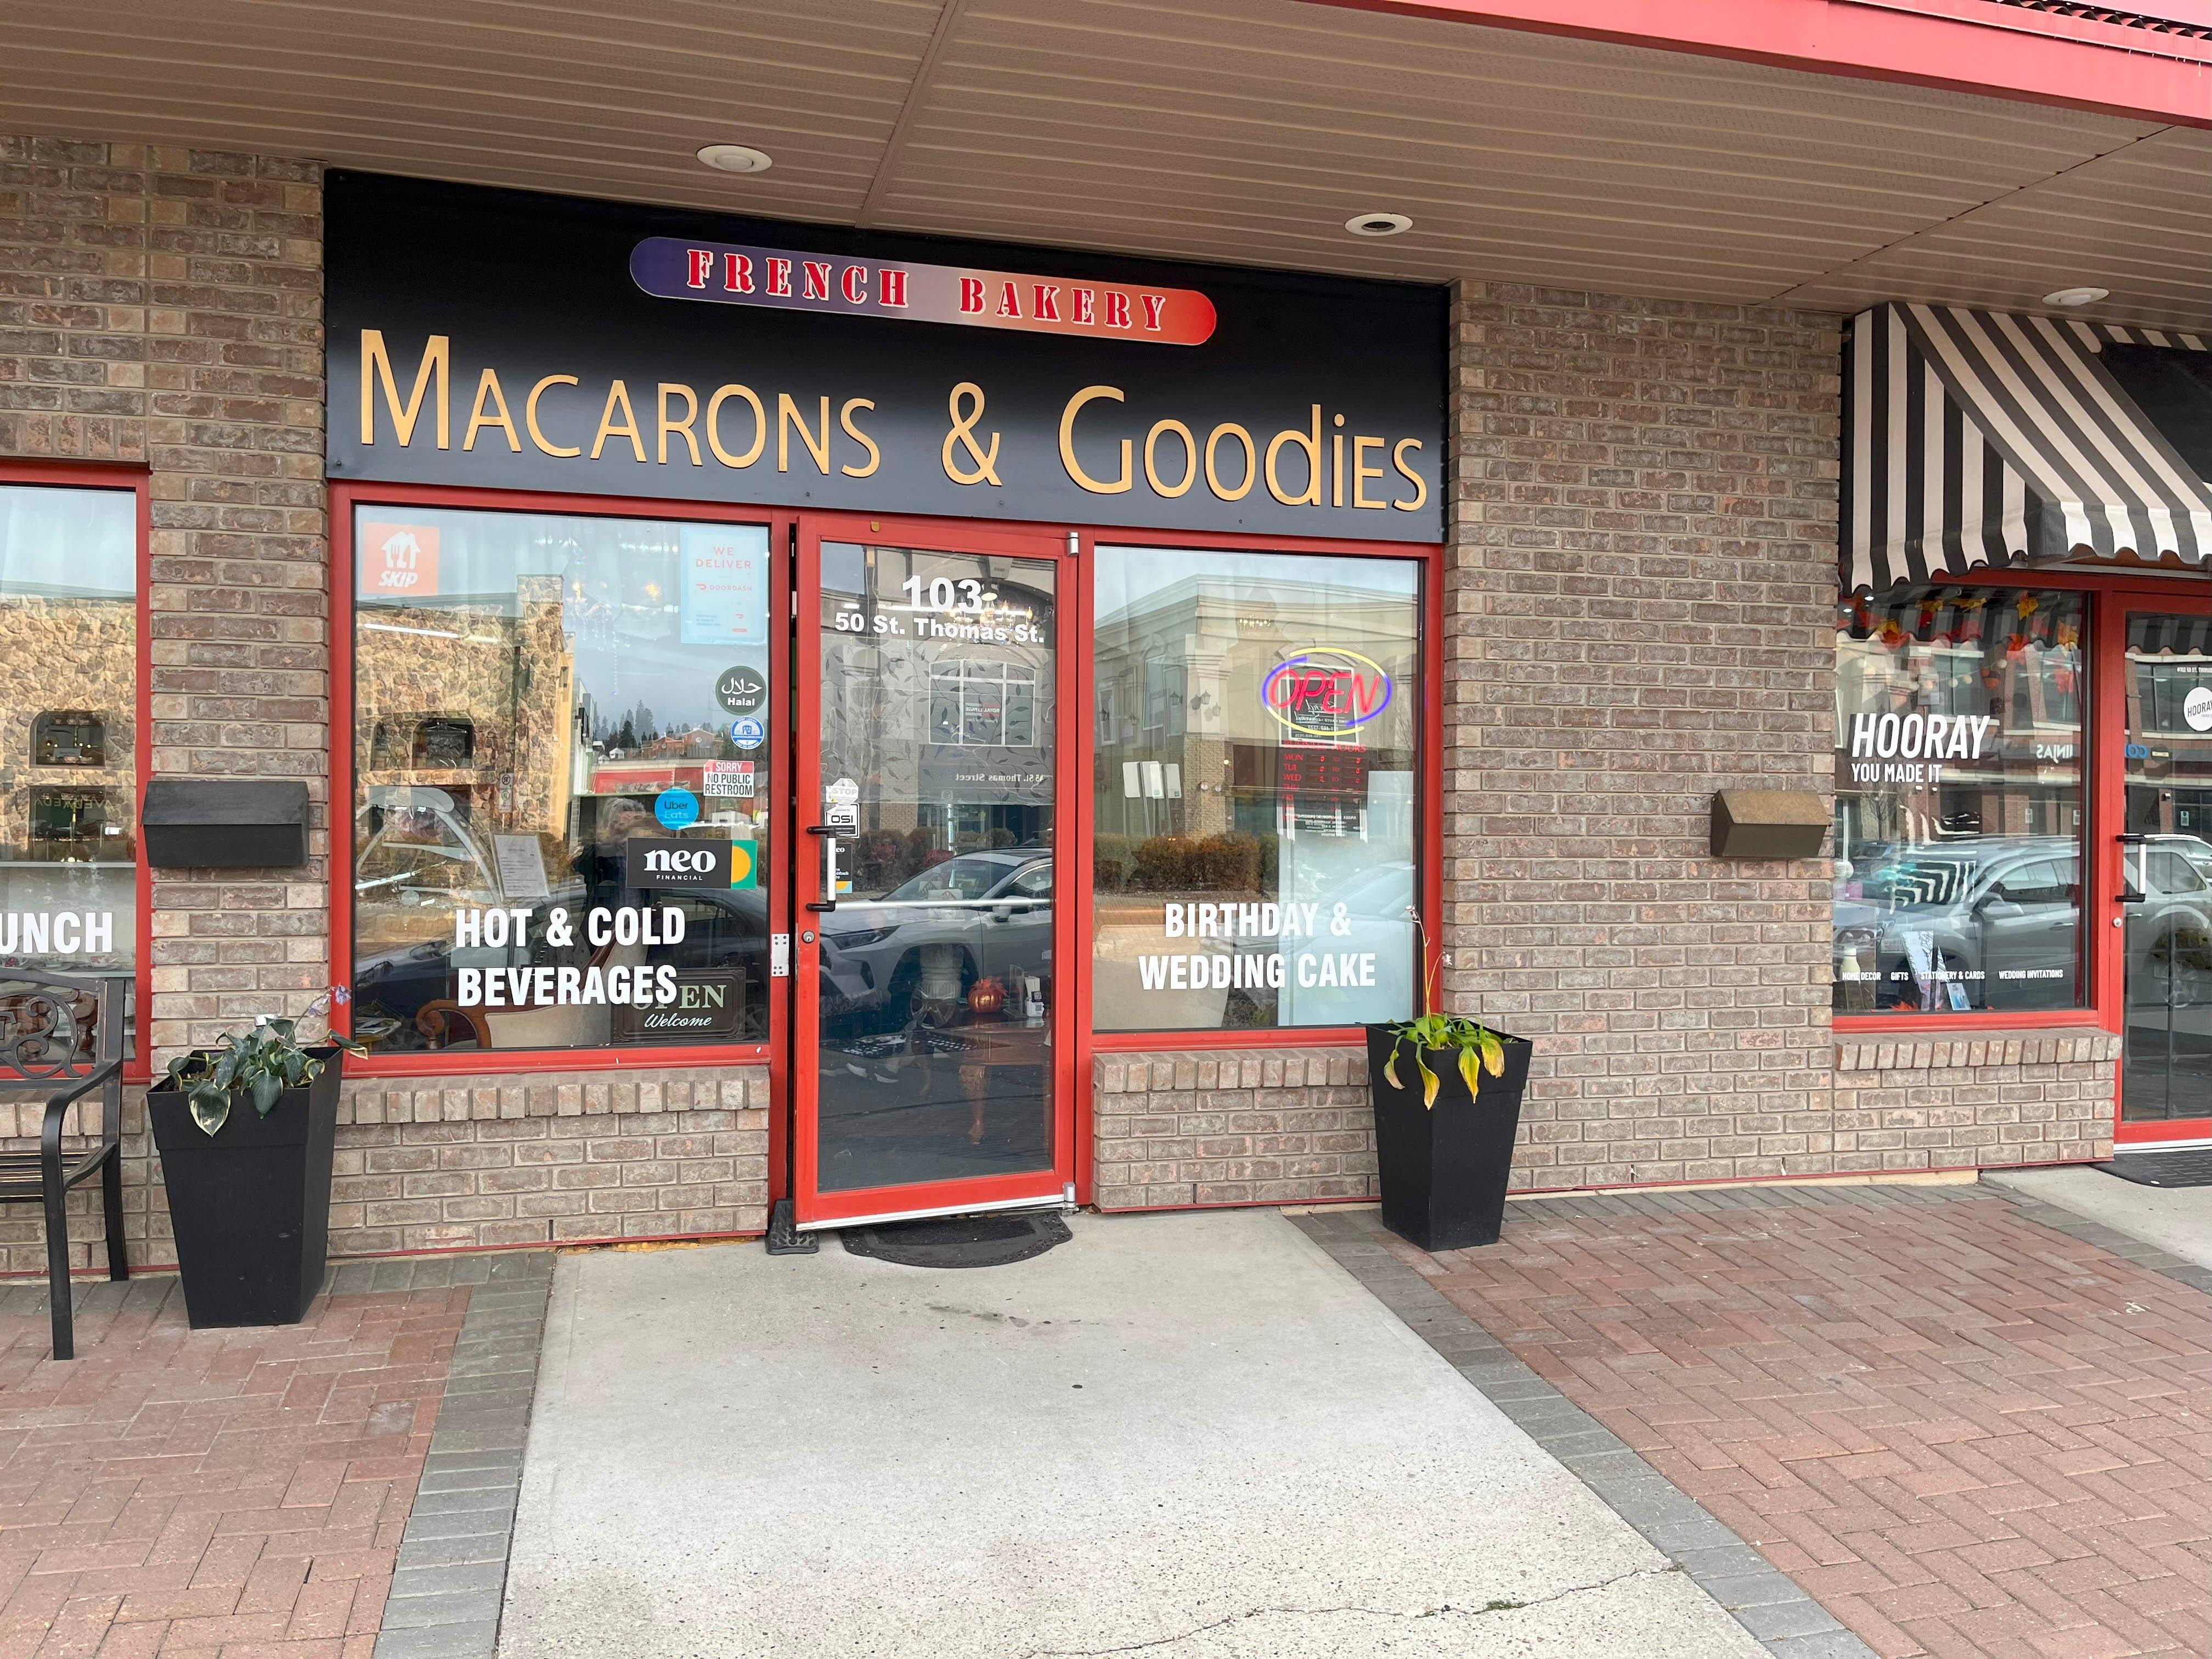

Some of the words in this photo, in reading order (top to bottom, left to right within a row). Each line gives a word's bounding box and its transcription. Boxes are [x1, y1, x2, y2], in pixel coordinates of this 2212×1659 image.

[686, 249, 909, 308] FRENCH
[958, 276, 1167, 331] BAKERY
[360, 329, 881, 478] MACARONS
[941, 382, 1002, 486] &
[713, 547, 733, 556] WE
[696, 559, 752, 568] DELIVER
[379, 570, 418, 588] SKIP
[902, 575, 983, 614] 103
[834, 612, 865, 633] 50
[873, 615, 906, 635] St.
[913, 618, 1007, 641] Thomas
[1014, 624, 1045, 643] St.
[721, 677, 763, 695] حلال
[1269, 669, 1380, 714] OPEN
[727, 697, 755, 706] Halal
[1851, 713, 1990, 759] HOORAY
[715, 761, 742, 772] SORRY
[1851, 763, 1880, 782] YOU
[1884, 764, 1924, 783] MADE
[1928, 764, 1943, 783] IT
[707, 774, 719, 783] NO
[721, 774, 751, 785] PUBLIC
[705, 784, 753, 795] RESTROOM
[832, 787, 857, 795] STOP
[664, 801, 688, 809] Uber
[664, 810, 689, 819] Eats
[831, 815, 854, 823] OSI
[644, 848, 716, 873] neo
[455, 907, 532, 947] HOT
[546, 907, 574, 947] &
[588, 906, 685, 946] COLD
[1165, 902, 1319, 938] BIRTHDAY
[1330, 902, 1352, 936] &
[1138, 953, 1285, 990] WEDDING
[1297, 952, 1376, 988] CAKE
[1842, 972, 1860, 981] HOME
[1860, 972, 1881, 981] DECOR
[1891, 972, 1909, 981] GIFTS
[1959, 970, 1963, 980] &
[1965, 970, 1985, 980] CARDS
[1998, 970, 2027, 980] WEDDING
[2027, 969, 2064, 979] INVITATIONS
[458, 964, 678, 1007] BEVERAGES
[644, 1013, 712, 1029] Welcome
